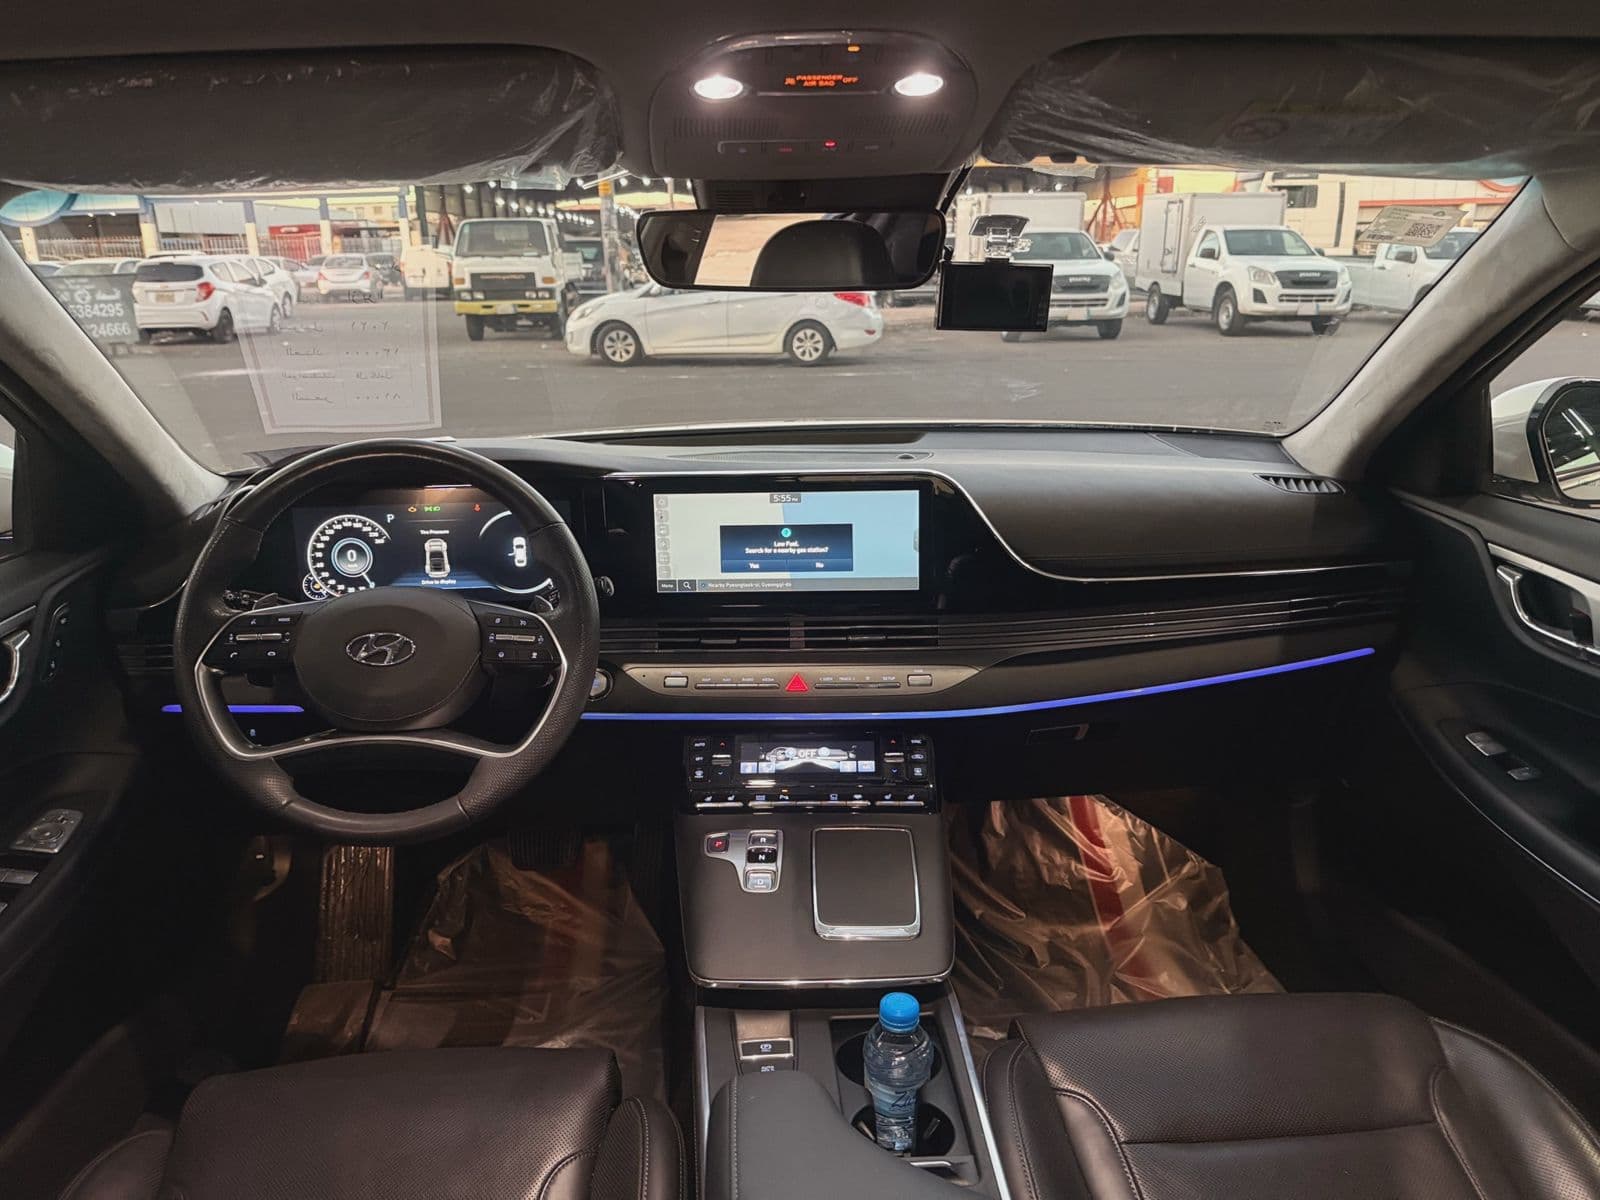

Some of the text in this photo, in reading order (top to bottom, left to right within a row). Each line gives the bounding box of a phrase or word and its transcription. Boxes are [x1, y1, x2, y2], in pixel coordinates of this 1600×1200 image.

[773, 494, 791, 502] 5:55
[386, 513, 395, 523] P
[347, 549, 357, 562] 0
[798, 750, 817, 759] OFF
